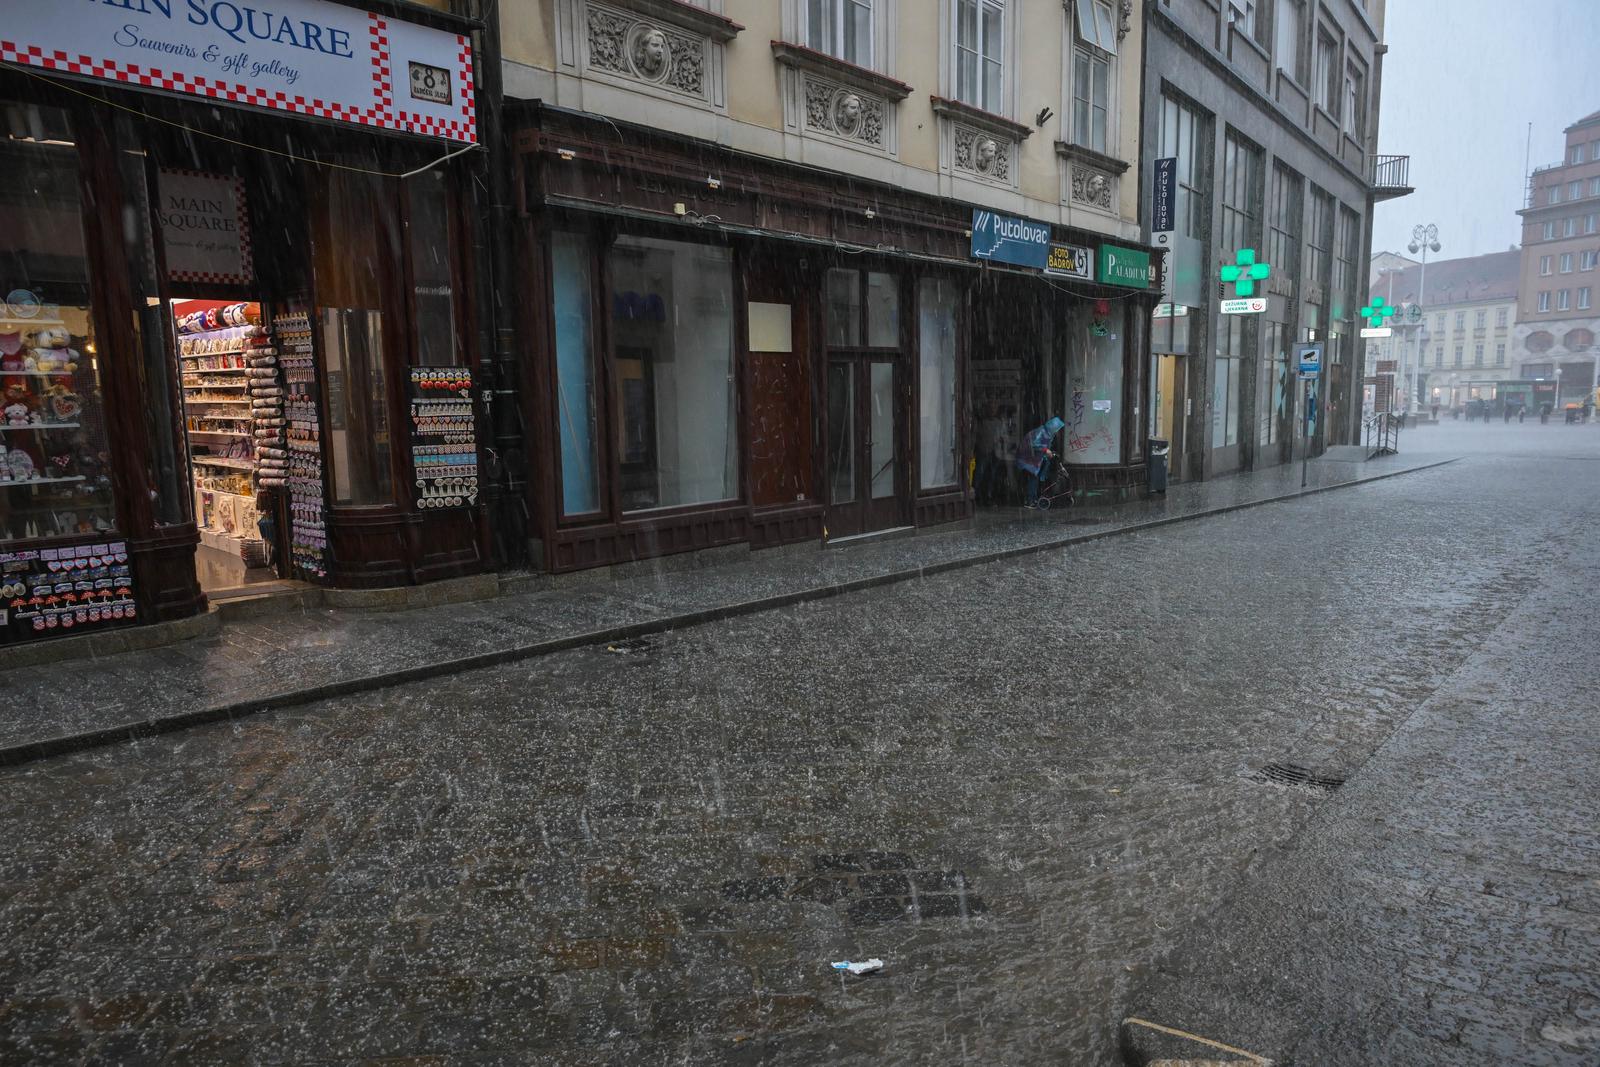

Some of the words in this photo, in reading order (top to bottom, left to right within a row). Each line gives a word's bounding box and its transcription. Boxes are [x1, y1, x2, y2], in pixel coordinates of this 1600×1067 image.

[188, 0, 353, 58] SQUARE
[113, 24, 198, 58] Souvenirs
[202, 44, 220, 62] &
[222, 53, 248, 75] gift
[250, 59, 300, 84] gallery
[424, 67, 435, 88] 8
[170, 196, 222, 214] MAIN
[1160, 171, 1168, 229] Putolovac
[160, 212, 236, 232] SQUARE
[994, 214, 1048, 245] Putolovac
[1048, 255, 1075, 270] BADROV
[1054, 248, 1068, 258] FOTO
